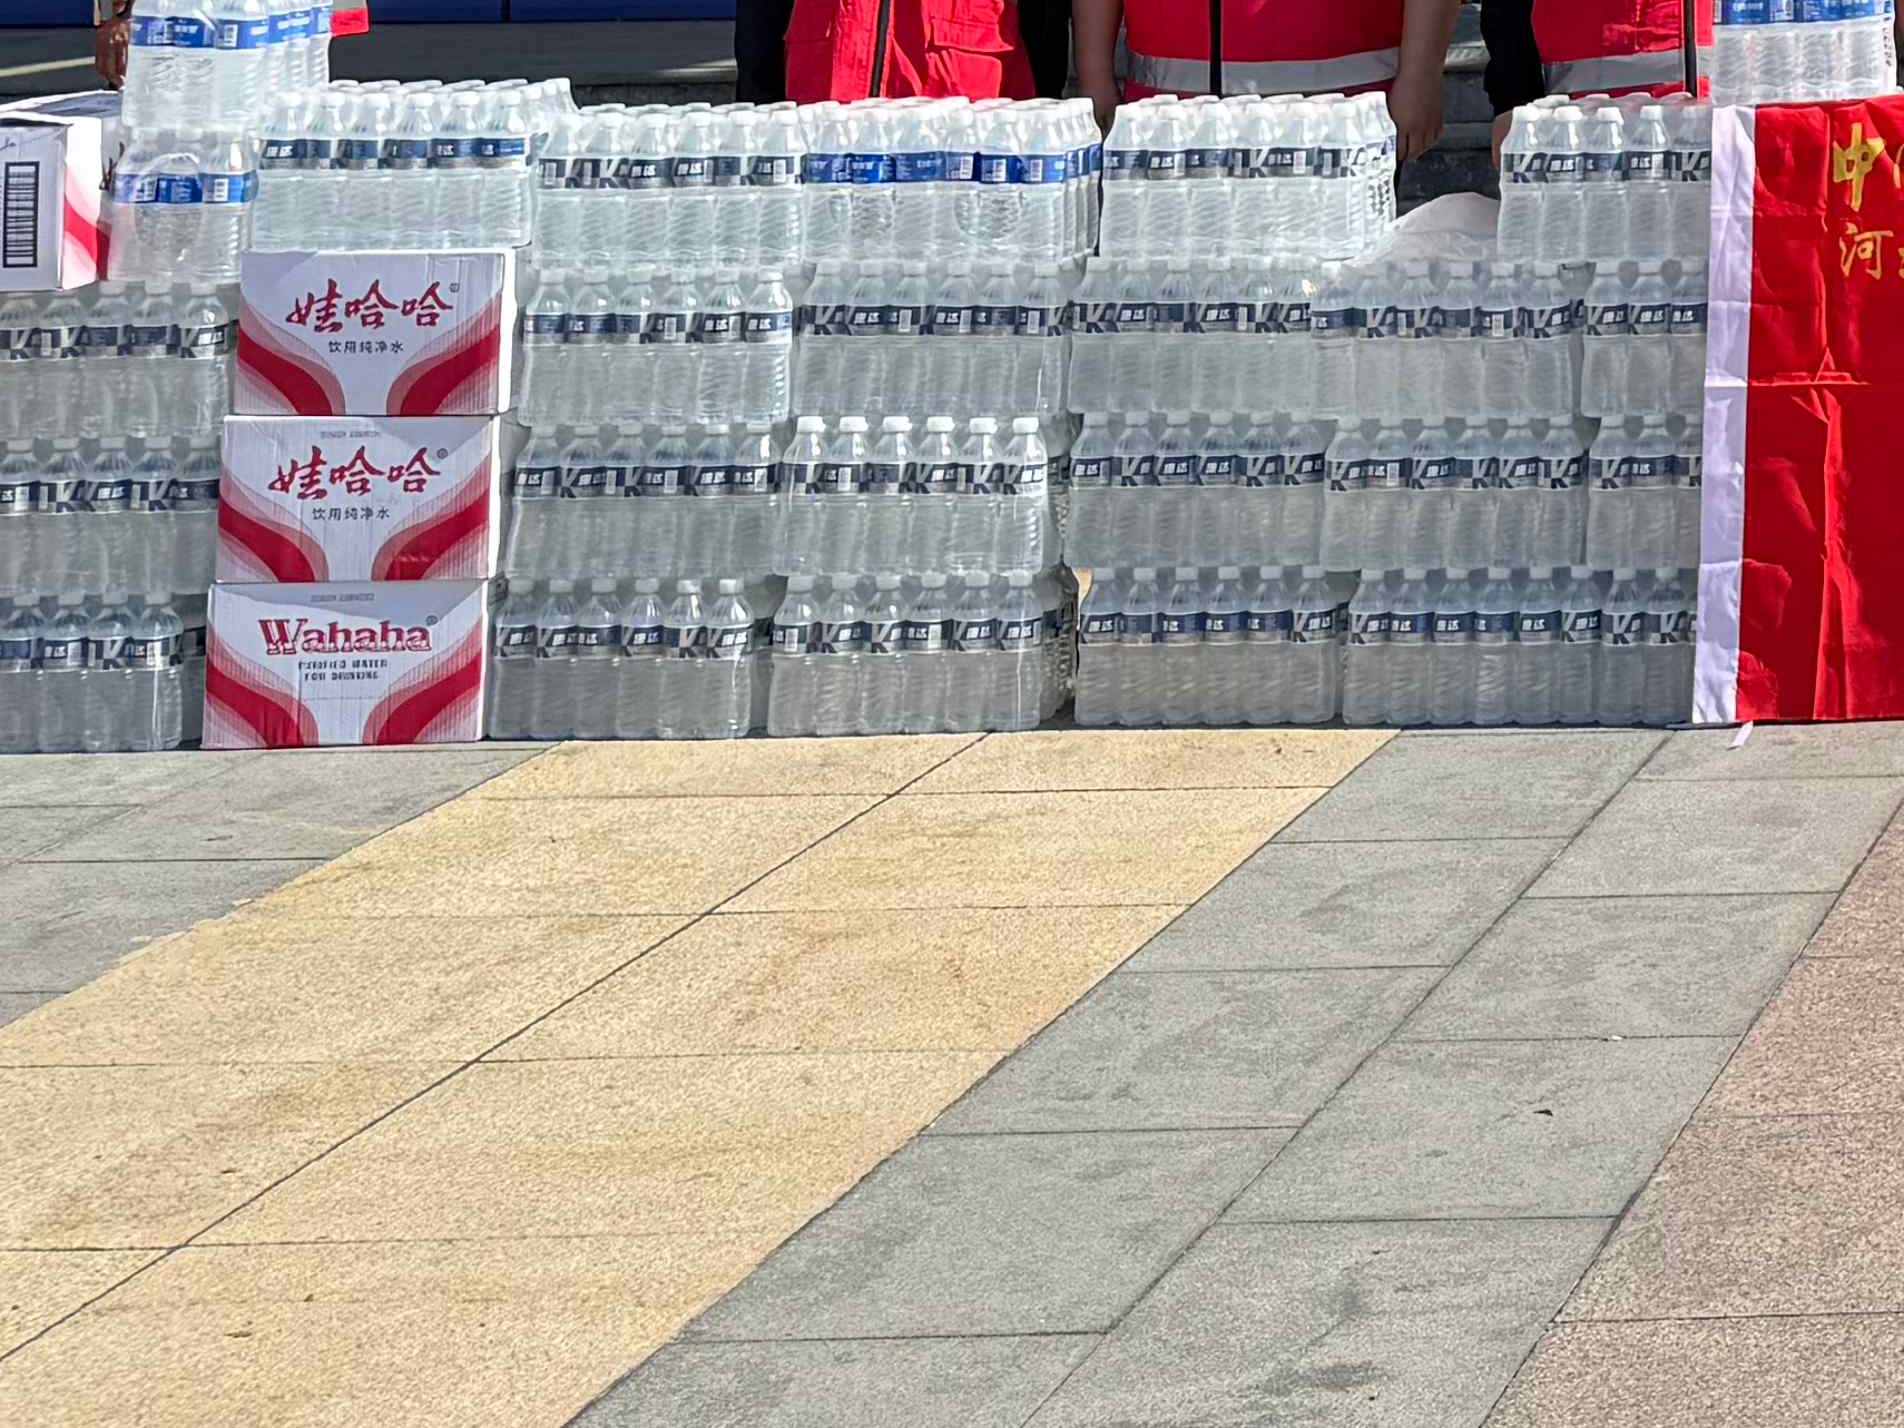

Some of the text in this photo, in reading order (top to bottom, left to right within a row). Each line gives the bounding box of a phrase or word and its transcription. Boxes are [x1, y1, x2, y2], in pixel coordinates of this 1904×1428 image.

[286, 278, 453, 332] 娃哈哈
[329, 341, 404, 353] 饮用纯净水
[268, 446, 441, 500] 娃哈哈
[312, 507, 391, 521] 饮用纯净水
[258, 619, 432, 655] Wahaha
